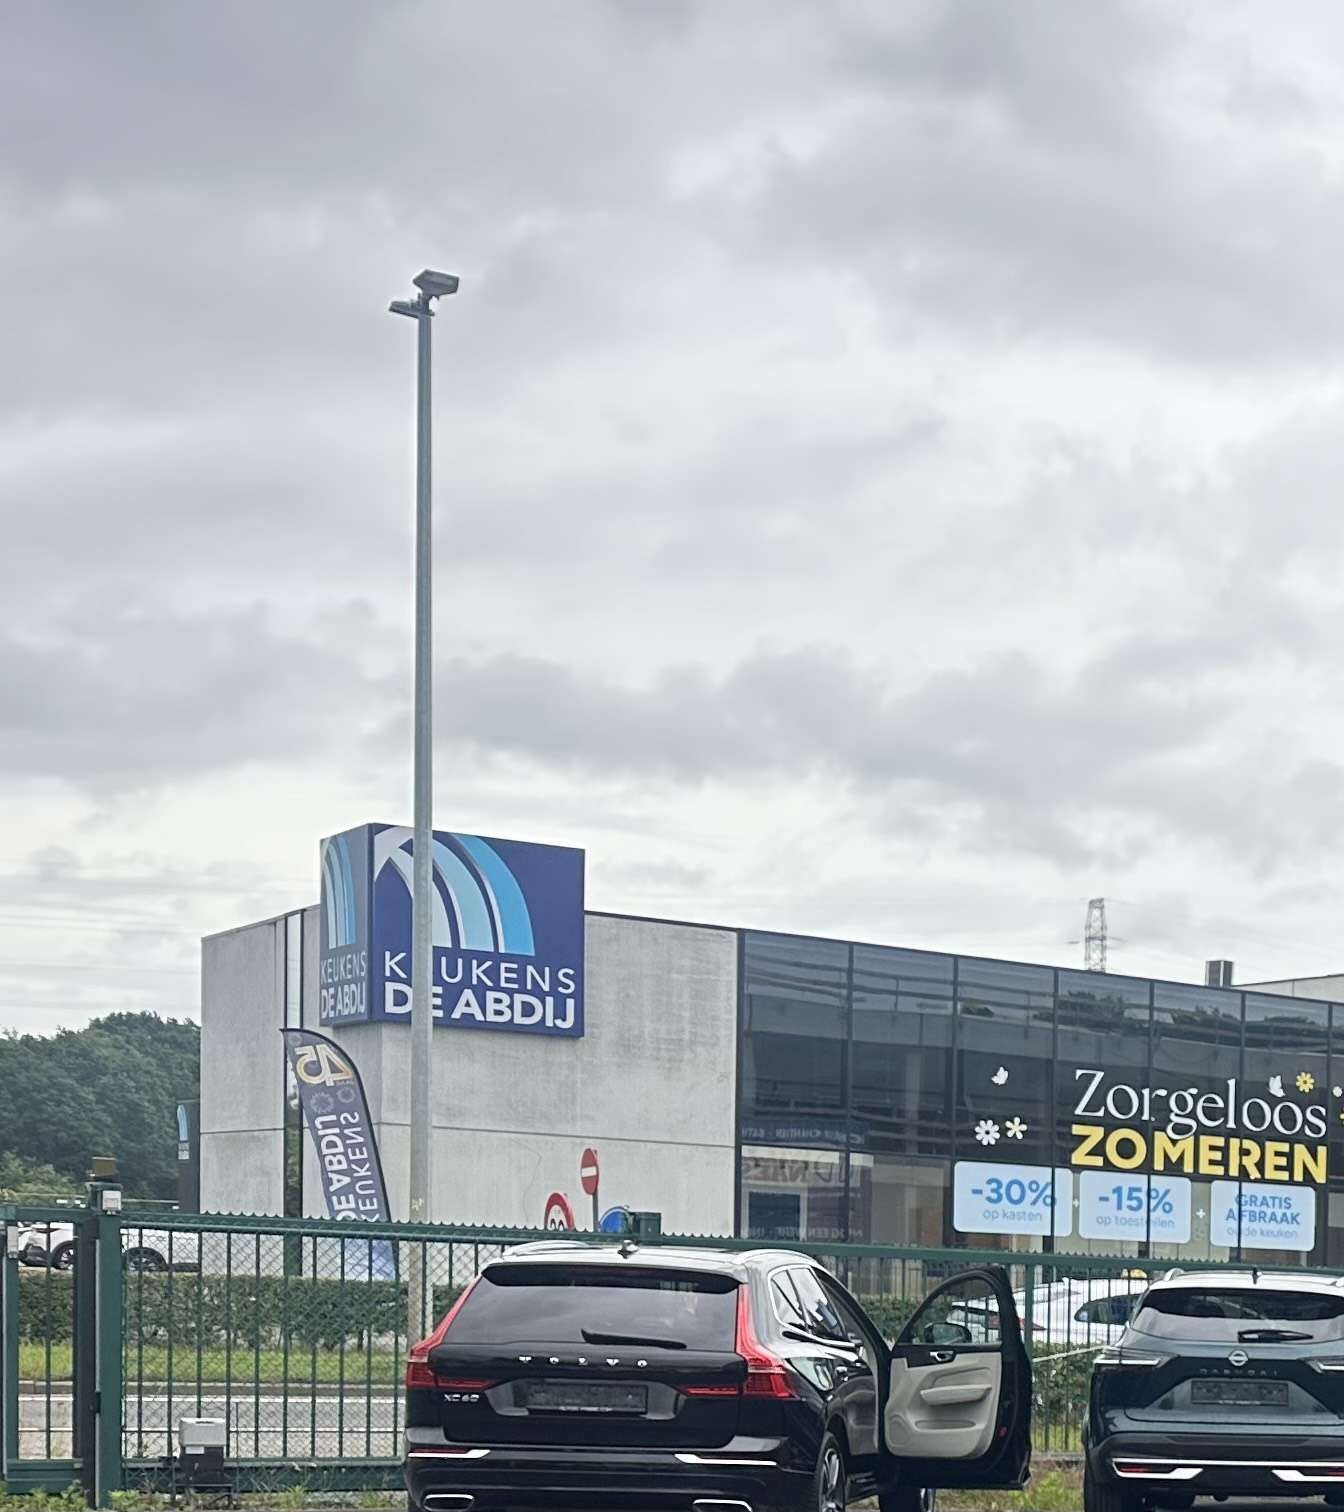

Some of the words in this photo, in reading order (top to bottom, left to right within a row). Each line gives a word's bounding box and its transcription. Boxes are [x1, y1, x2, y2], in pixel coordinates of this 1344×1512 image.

[321, 949, 366, 986] KEUKENS
[384, 950, 576, 995] KUKENS
[320, 986, 335, 1021] DE
[336, 982, 366, 1017] ABDIJ
[451, 987, 575, 1030] ABDIJ
[1073, 1068, 1328, 1141] Zorgeloos
[1070, 1124, 1328, 1185] ZOMEREN
[970, 1176, 1057, 1207] -30%
[1098, 1185, 1174, 1215] -15%
[1235, 1193, 1293, 1210] GRATIS
[982, 1209, 1000, 1221] op
[1001, 1208, 1043, 1223] kasten
